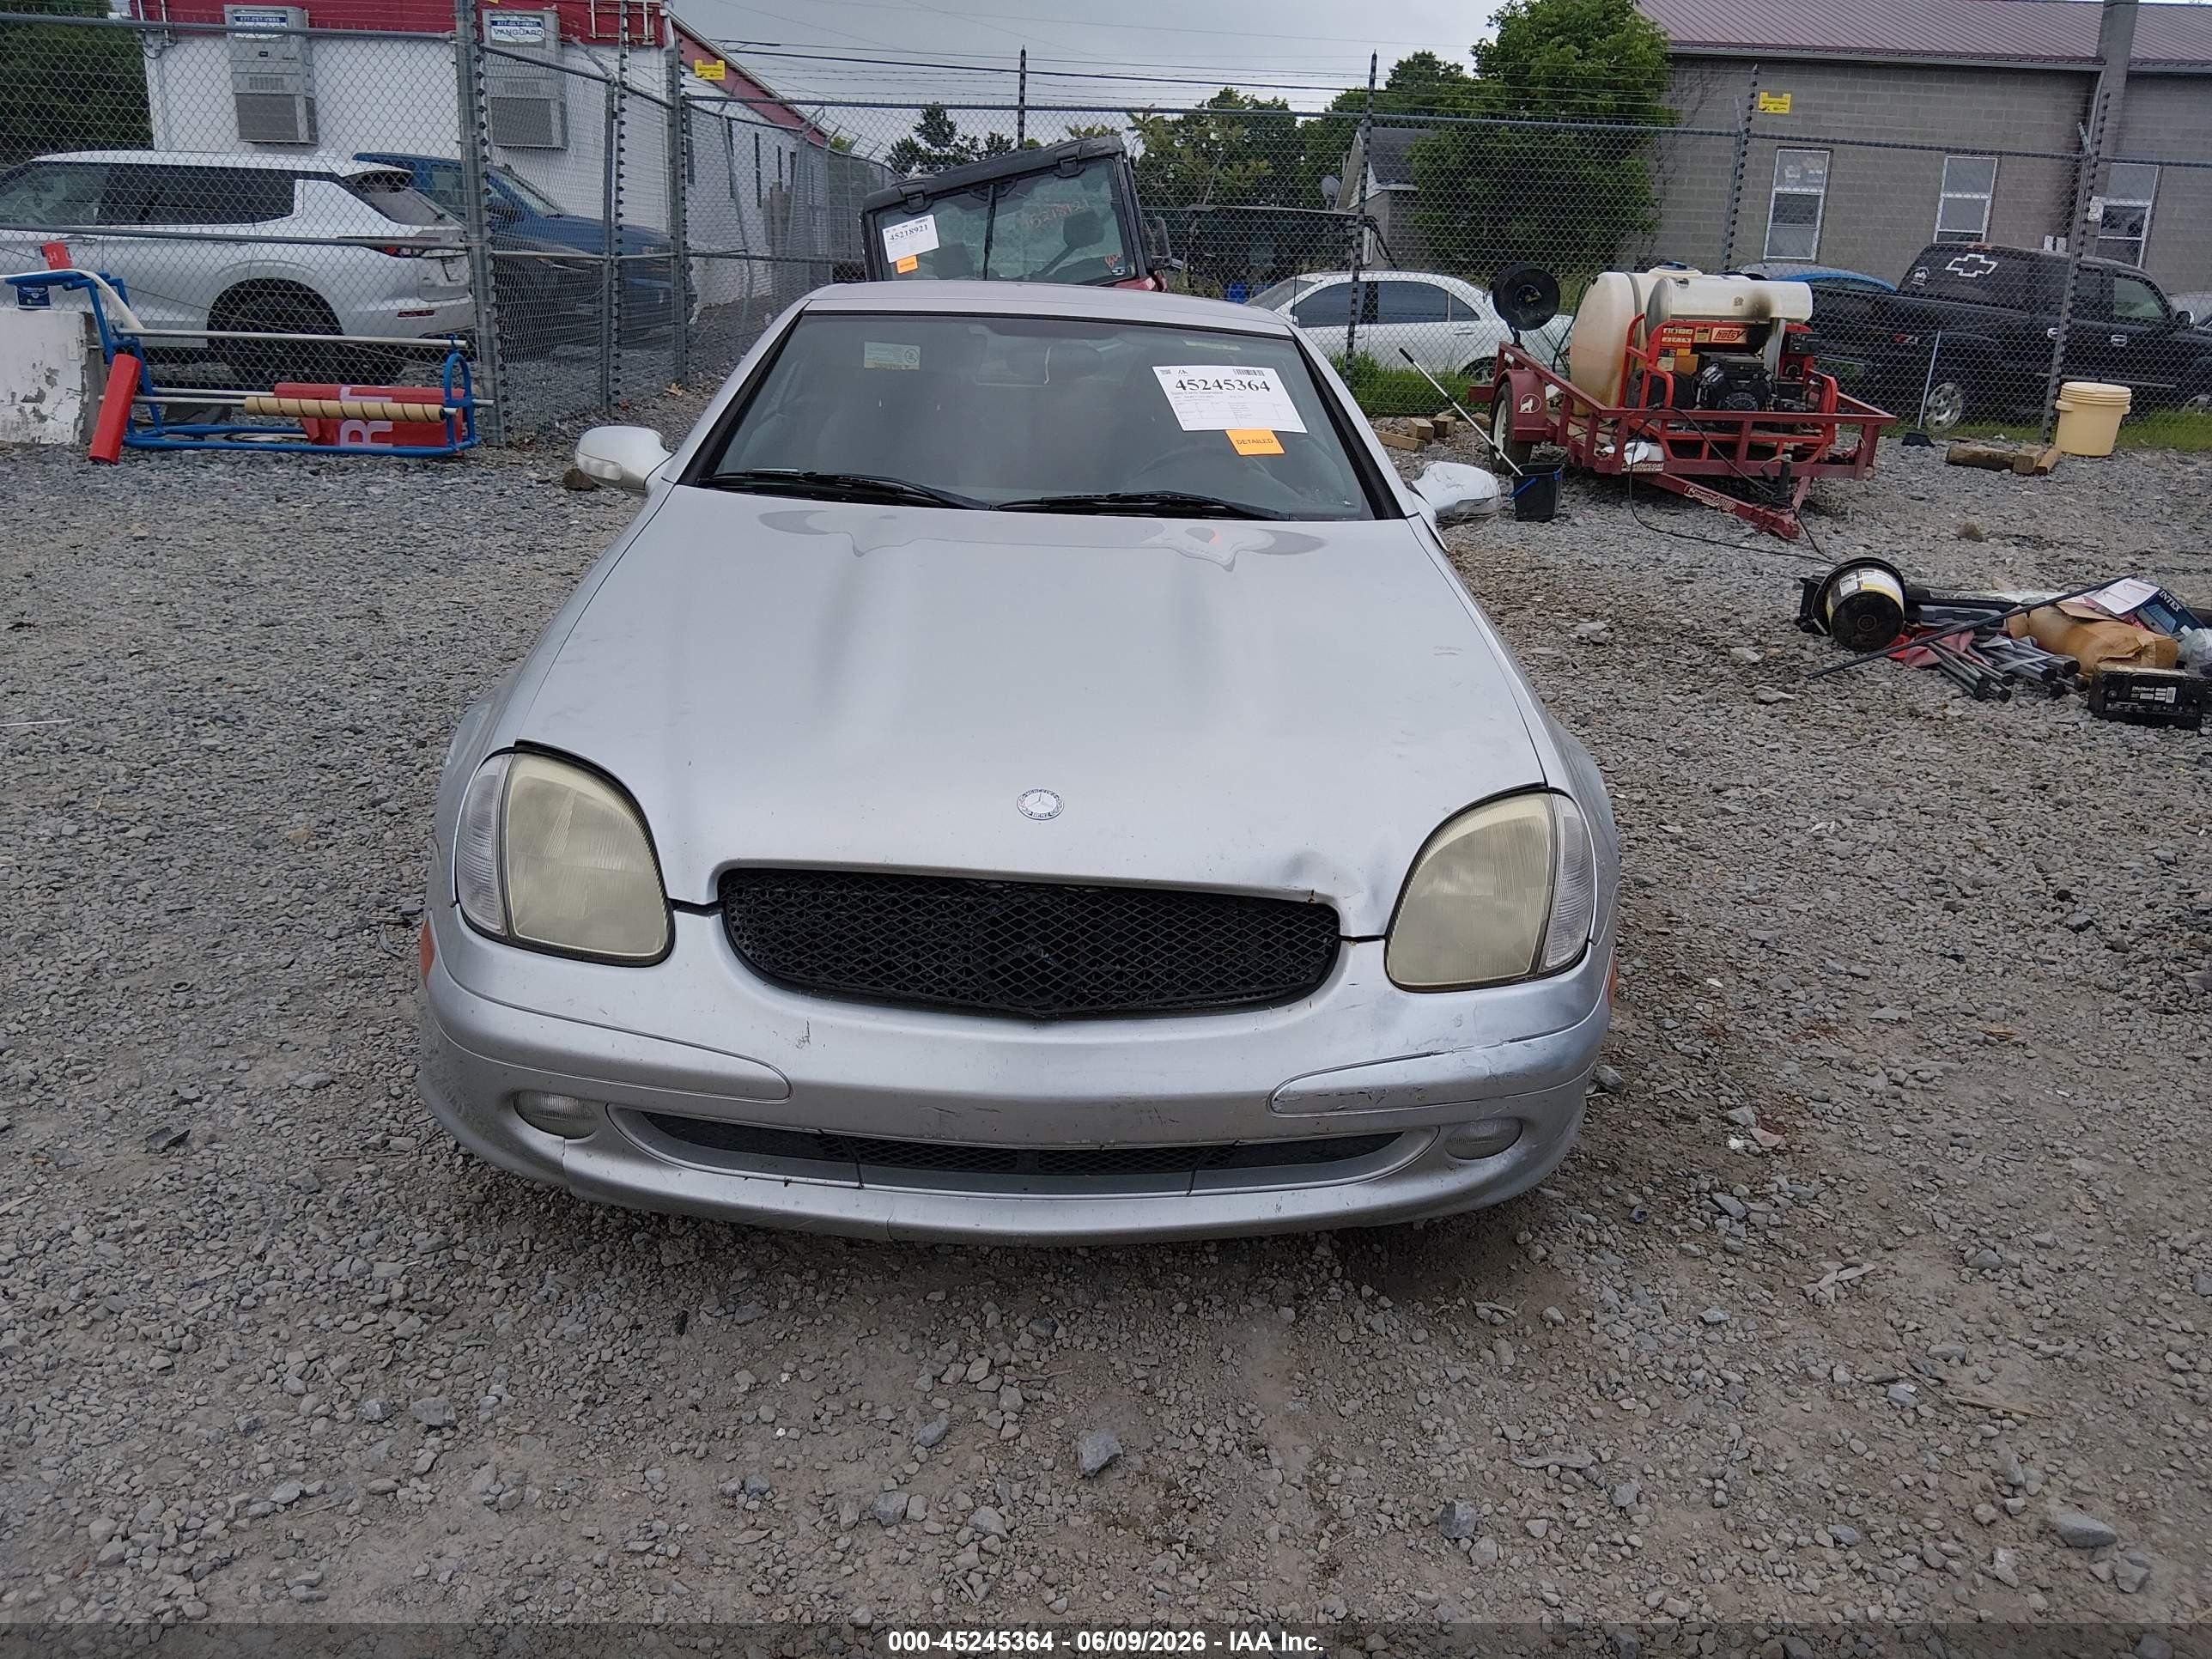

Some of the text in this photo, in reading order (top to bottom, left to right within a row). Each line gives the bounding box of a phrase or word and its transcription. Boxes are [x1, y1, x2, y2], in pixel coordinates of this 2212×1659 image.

[493, 27, 544, 36] VANGUARD
[890, 223, 928, 240] 45218921
[1175, 379, 1271, 392] 45245364
[2158, 589, 2183, 612] INTEX
